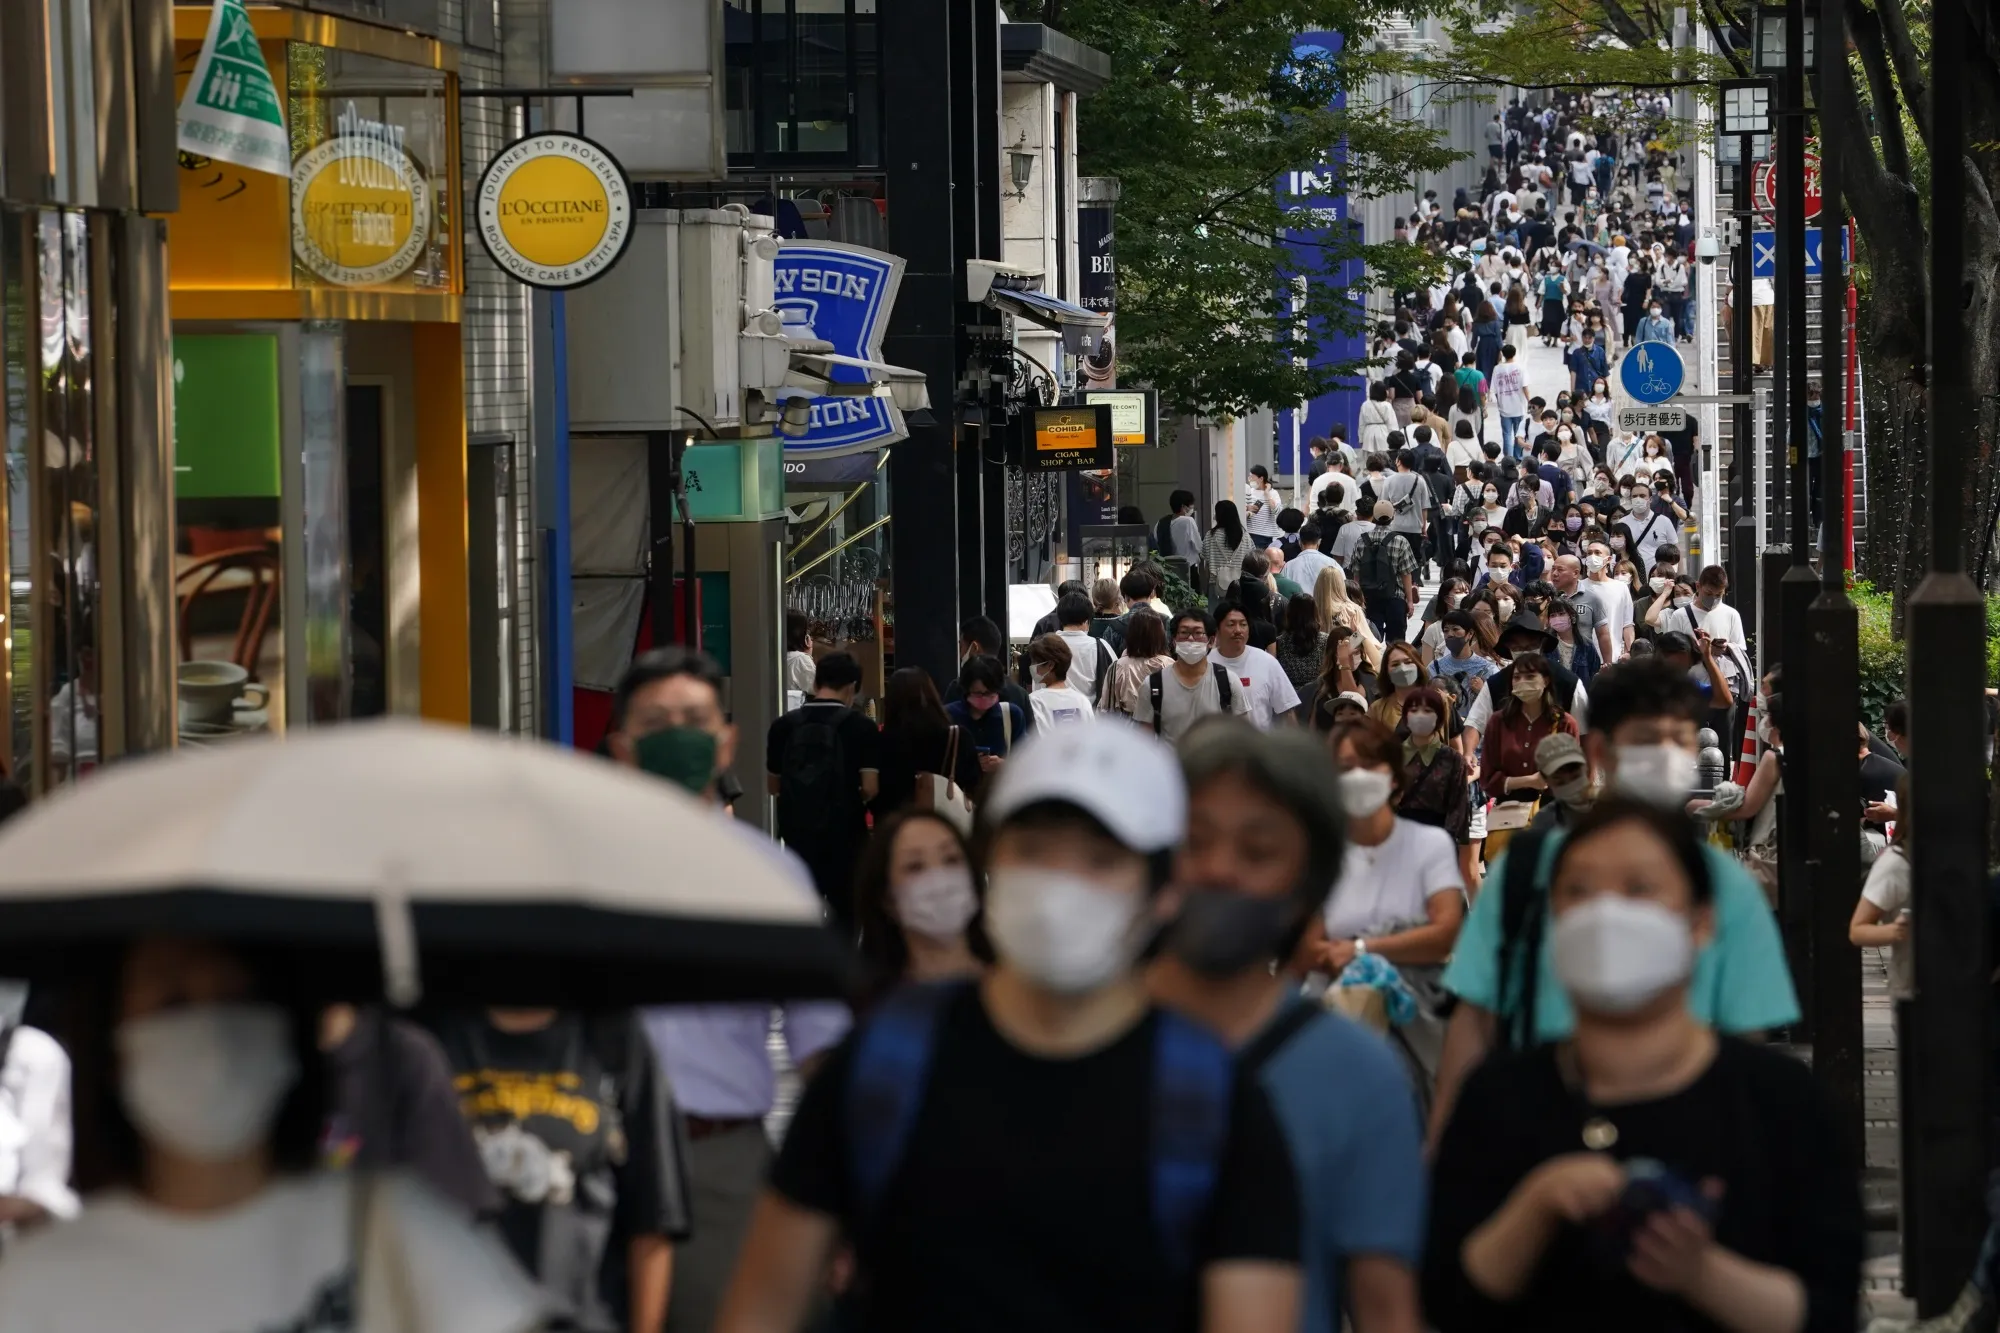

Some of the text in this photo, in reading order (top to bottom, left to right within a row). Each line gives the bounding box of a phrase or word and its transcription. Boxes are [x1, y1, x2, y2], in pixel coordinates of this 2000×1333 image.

[483, 140, 622, 202] JOURNEY TO PROVENCE
[501, 199, 605, 216] L'OCCITANE
[520, 216, 584, 225] EN PROVENCE
[485, 219, 624, 281] BOUTIQUE CAFÉ & PETIT SPA
[1624, 412, 1682, 427] 歩行者優先
[1048, 425, 1084, 433] COHIBA
[1040, 459, 1064, 467] SHOP
[1077, 457, 1095, 465] BAR
